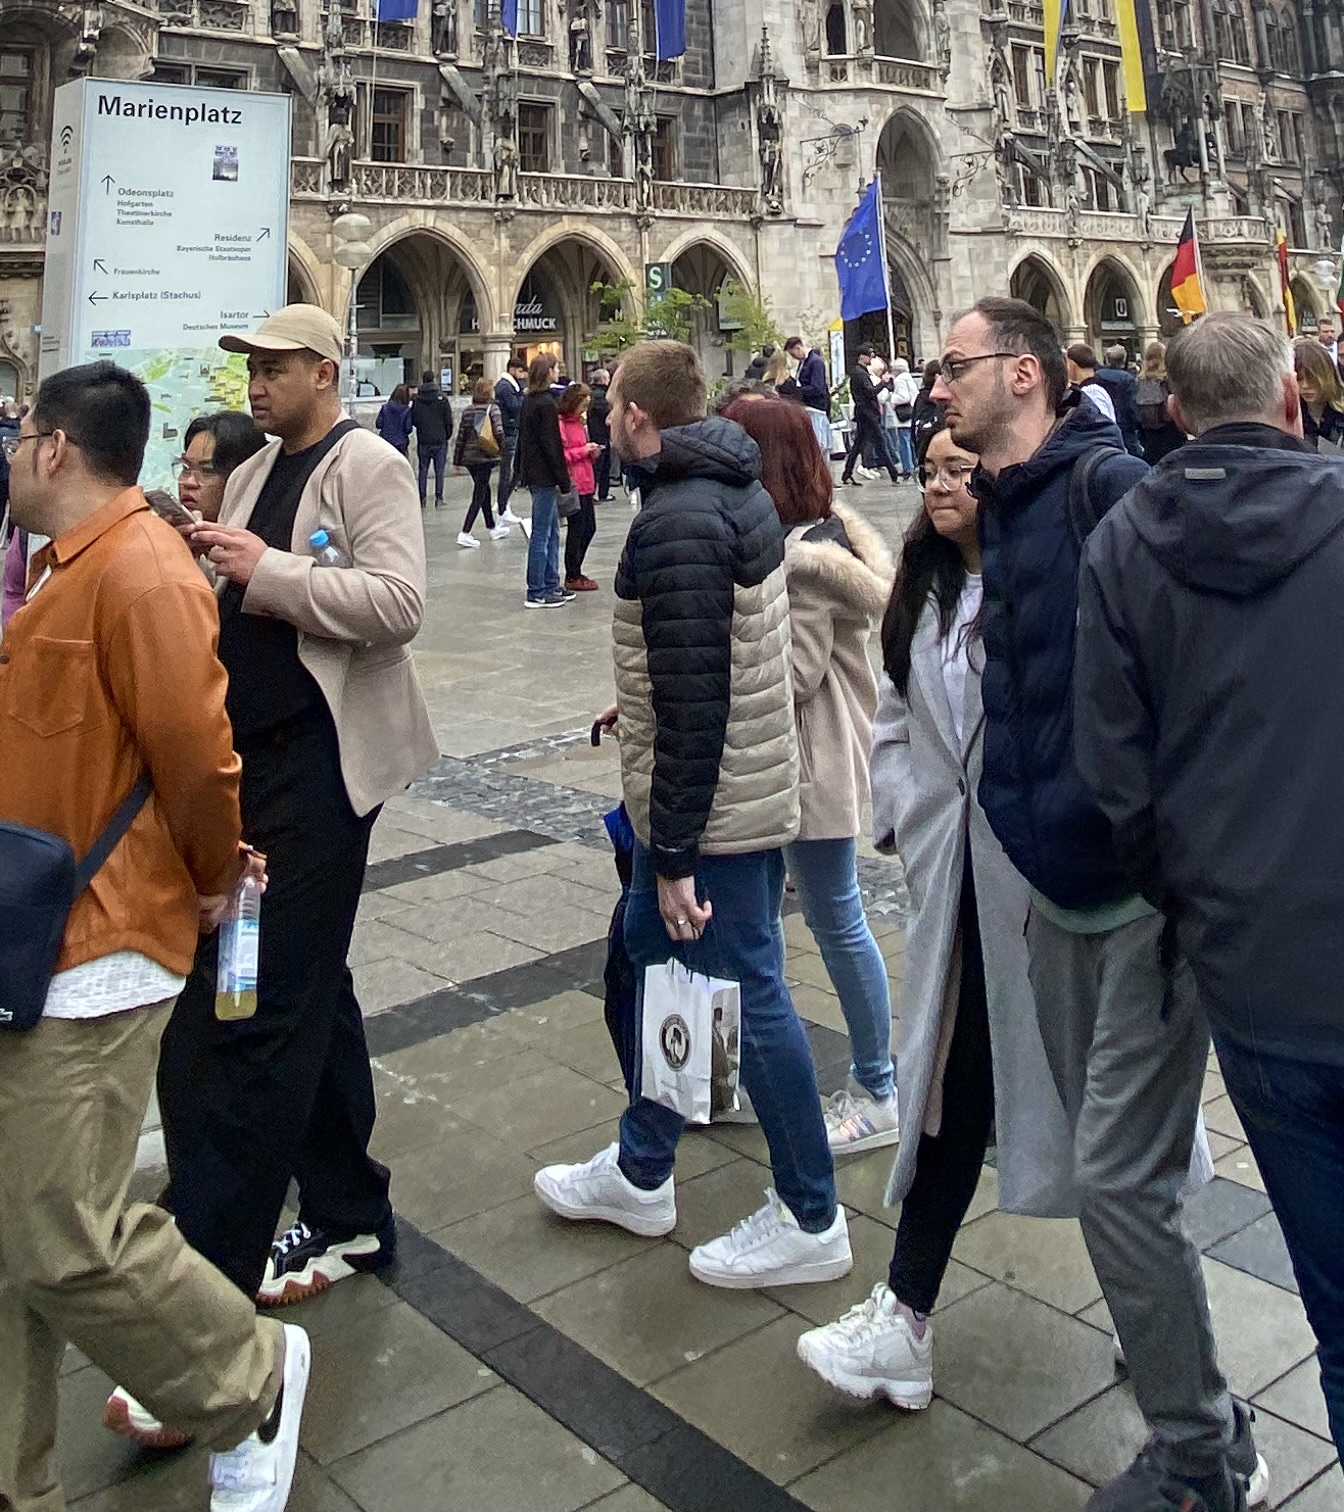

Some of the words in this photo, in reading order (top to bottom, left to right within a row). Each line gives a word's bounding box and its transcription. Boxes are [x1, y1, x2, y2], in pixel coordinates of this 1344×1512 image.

[97, 94, 243, 126] Marienplatz
[117, 187, 175, 199] Odeonsplatz
[649, 266, 662, 288] S
[112, 291, 158, 301] Karlsplatz
